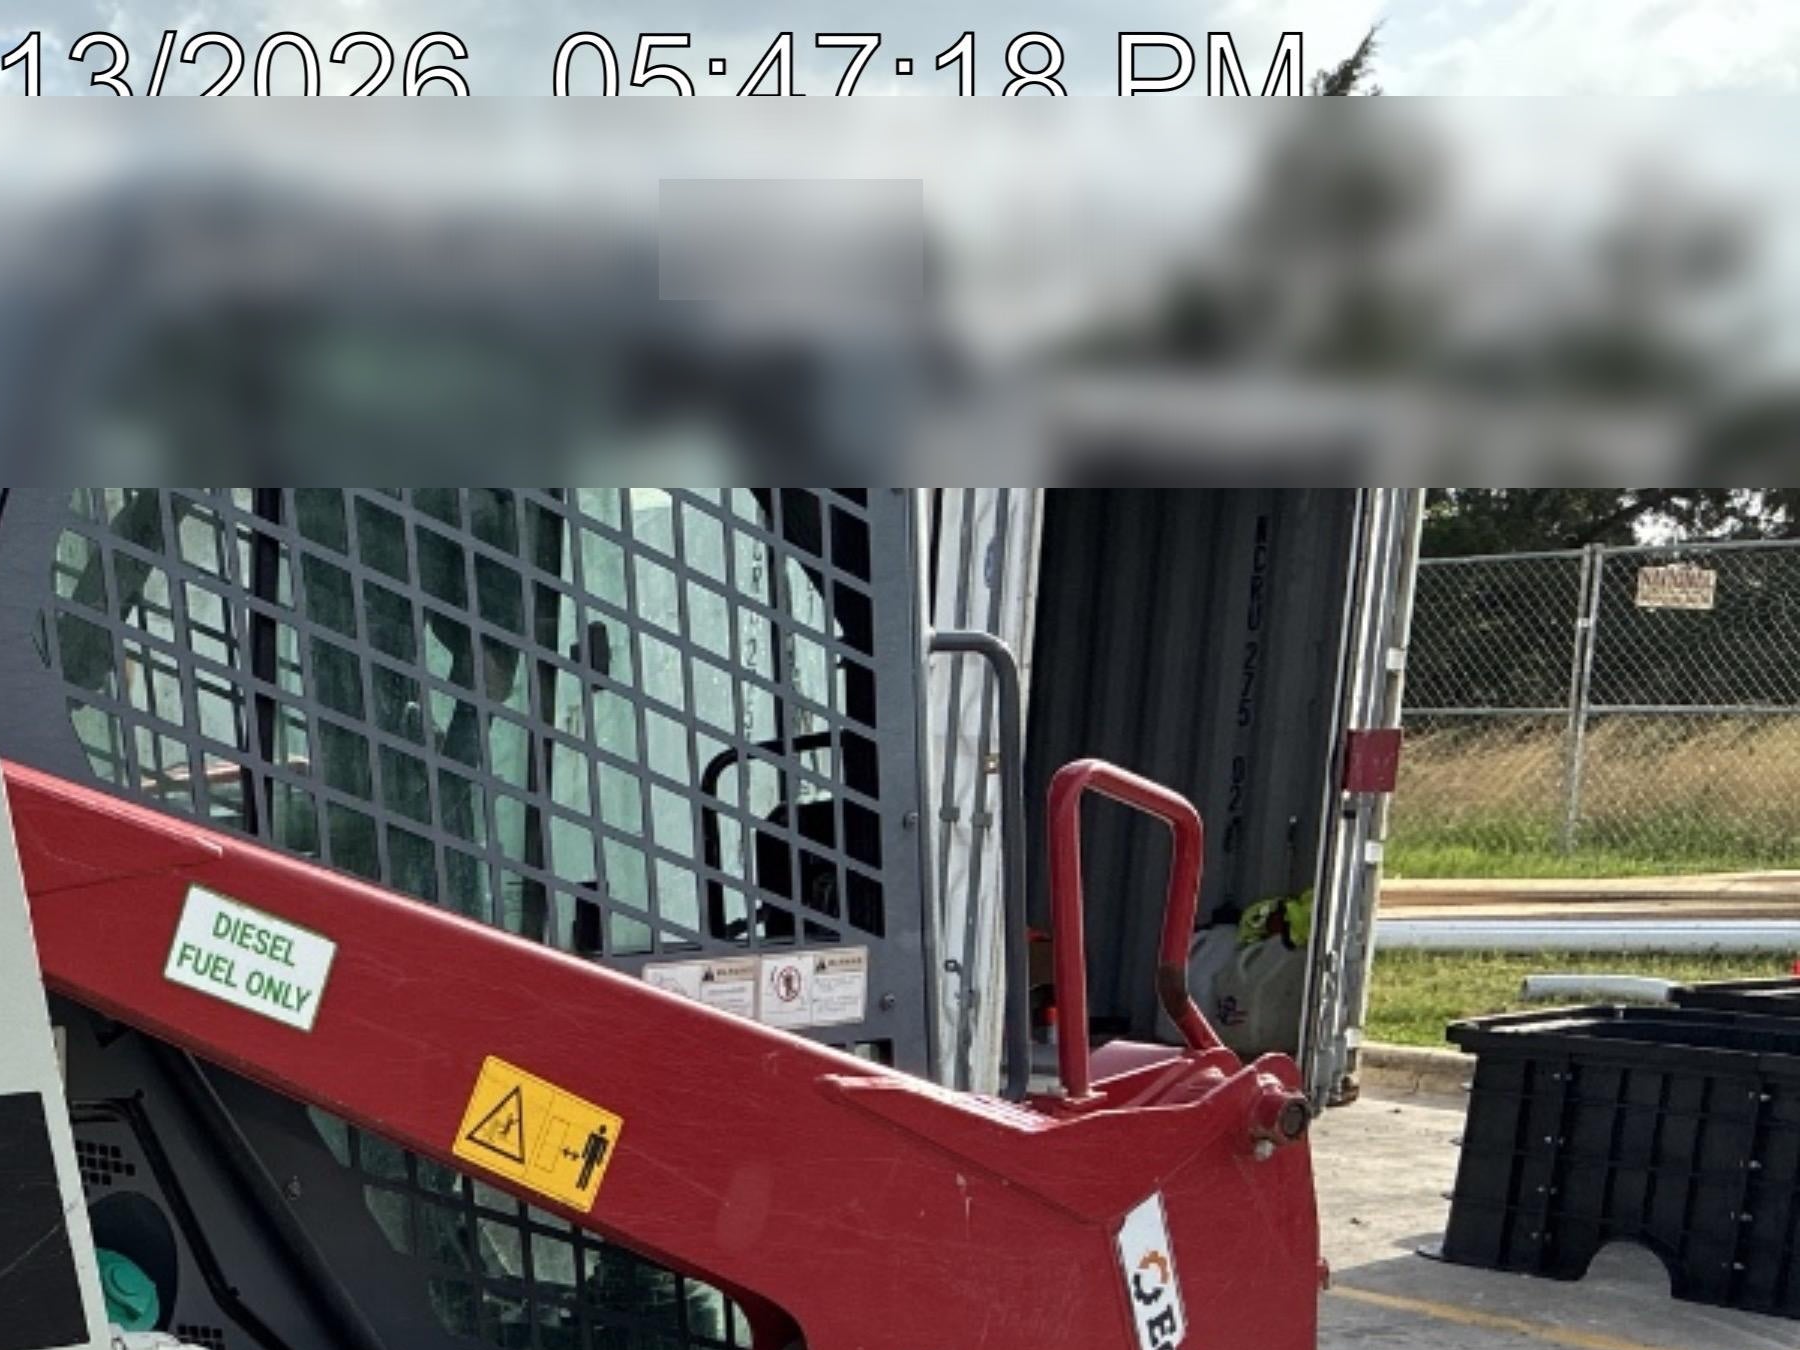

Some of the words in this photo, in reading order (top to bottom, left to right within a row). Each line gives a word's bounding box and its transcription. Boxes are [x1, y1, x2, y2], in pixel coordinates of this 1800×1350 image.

[212, 911, 295, 967] DIESEL
[177, 942, 237, 988] FUEL
[246, 969, 312, 1013] ONLY
